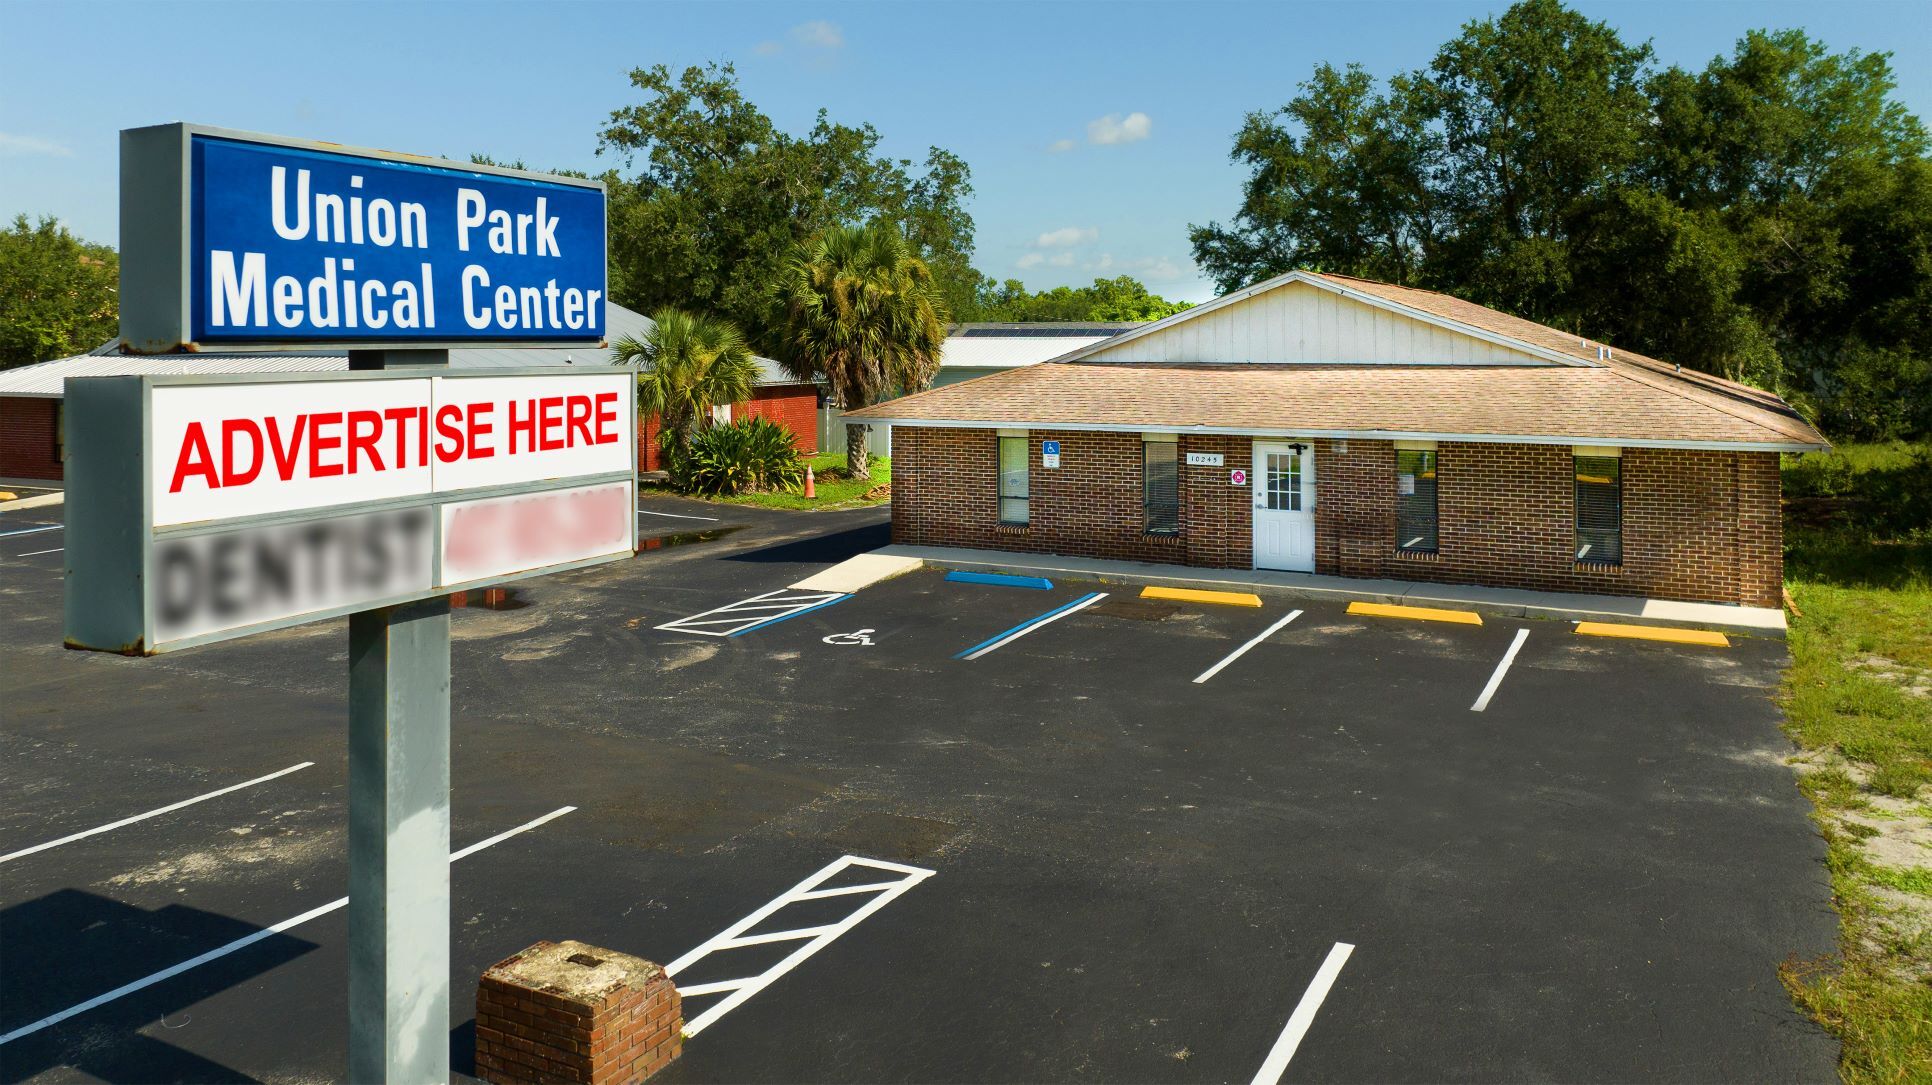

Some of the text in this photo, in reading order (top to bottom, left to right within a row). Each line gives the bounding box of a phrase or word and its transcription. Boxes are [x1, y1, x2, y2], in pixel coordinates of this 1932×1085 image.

[271, 166, 561, 257] Union Park
[211, 250, 601, 330] Medical Center
[168, 392, 619, 494] ADVERTISE HERE
[1190, 455, 1218, 464] 10245
